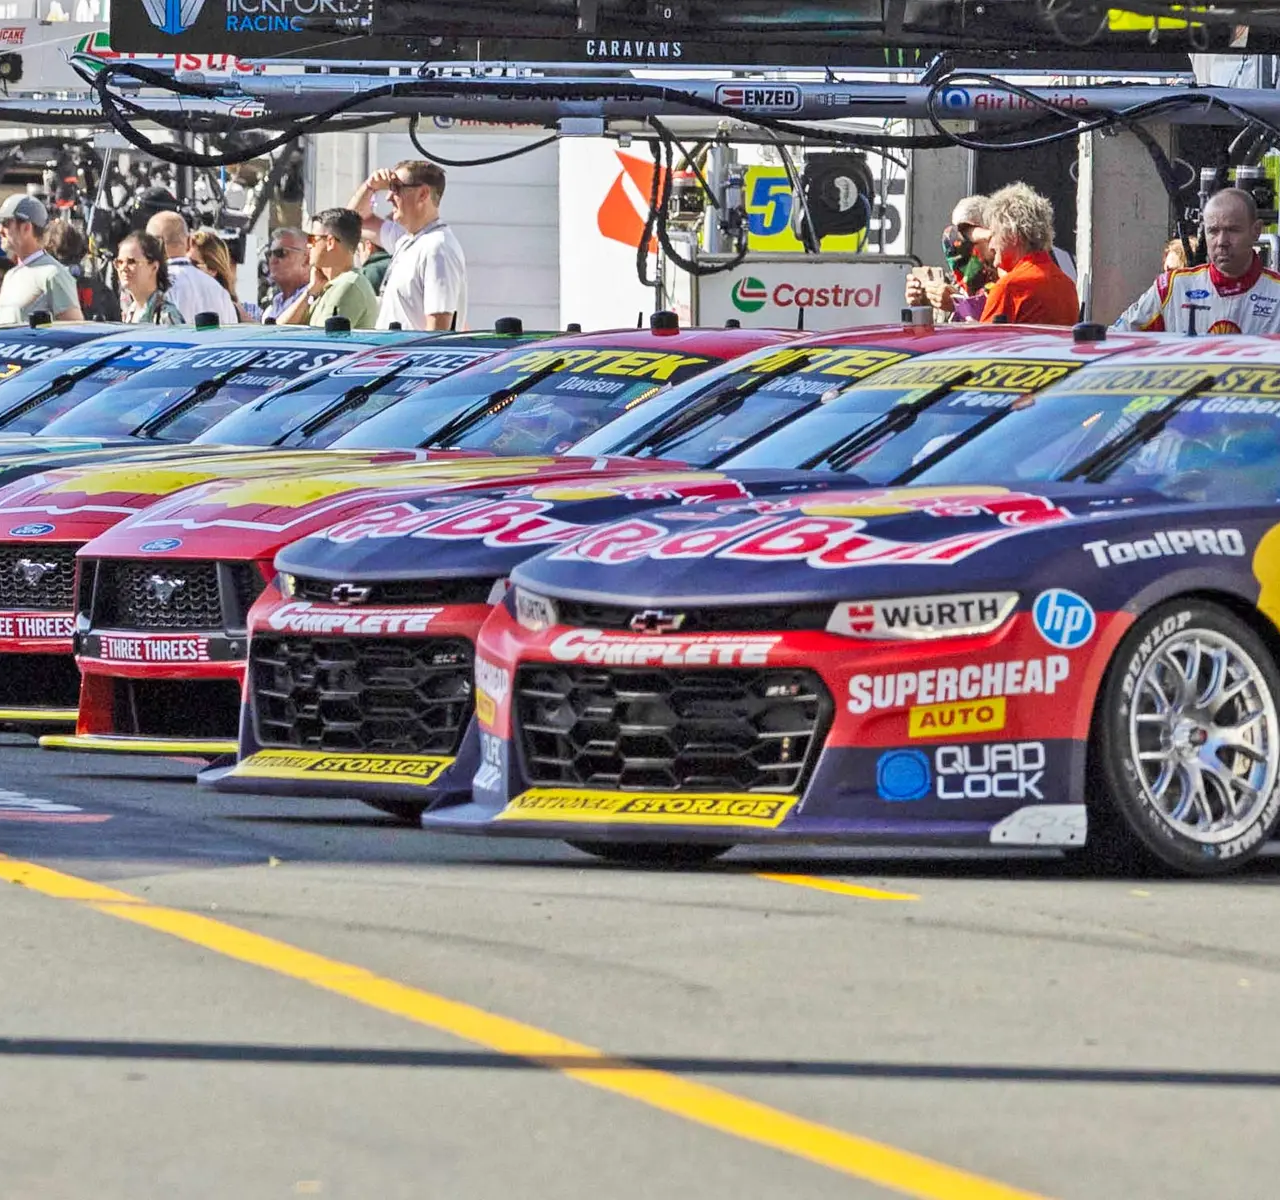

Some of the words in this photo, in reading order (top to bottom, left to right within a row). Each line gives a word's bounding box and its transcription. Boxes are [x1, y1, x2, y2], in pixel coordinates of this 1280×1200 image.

[586, 39, 683, 58] CARAVANS
[744, 88, 796, 108] ENZED
[772, 283, 881, 309] Castrol
[556, 376, 623, 395] Davison
[1083, 528, 1246, 569] ToolPRO
[882, 596, 1000, 630] WÜRTH
[1042, 594, 1085, 643] hp
[19, 616, 74, 638] THREES
[108, 638, 142, 661] THREE
[144, 638, 199, 662] THREES
[1122, 611, 1192, 699] DUNLOP
[847, 655, 1071, 715] SUPERCHEAP
[919, 704, 995, 730] AUTO
[318, 757, 433, 777] STORAGE
[935, 741, 1045, 775] QUAD
[936, 770, 1045, 800] LOCK
[632, 794, 778, 823] STORAGE
